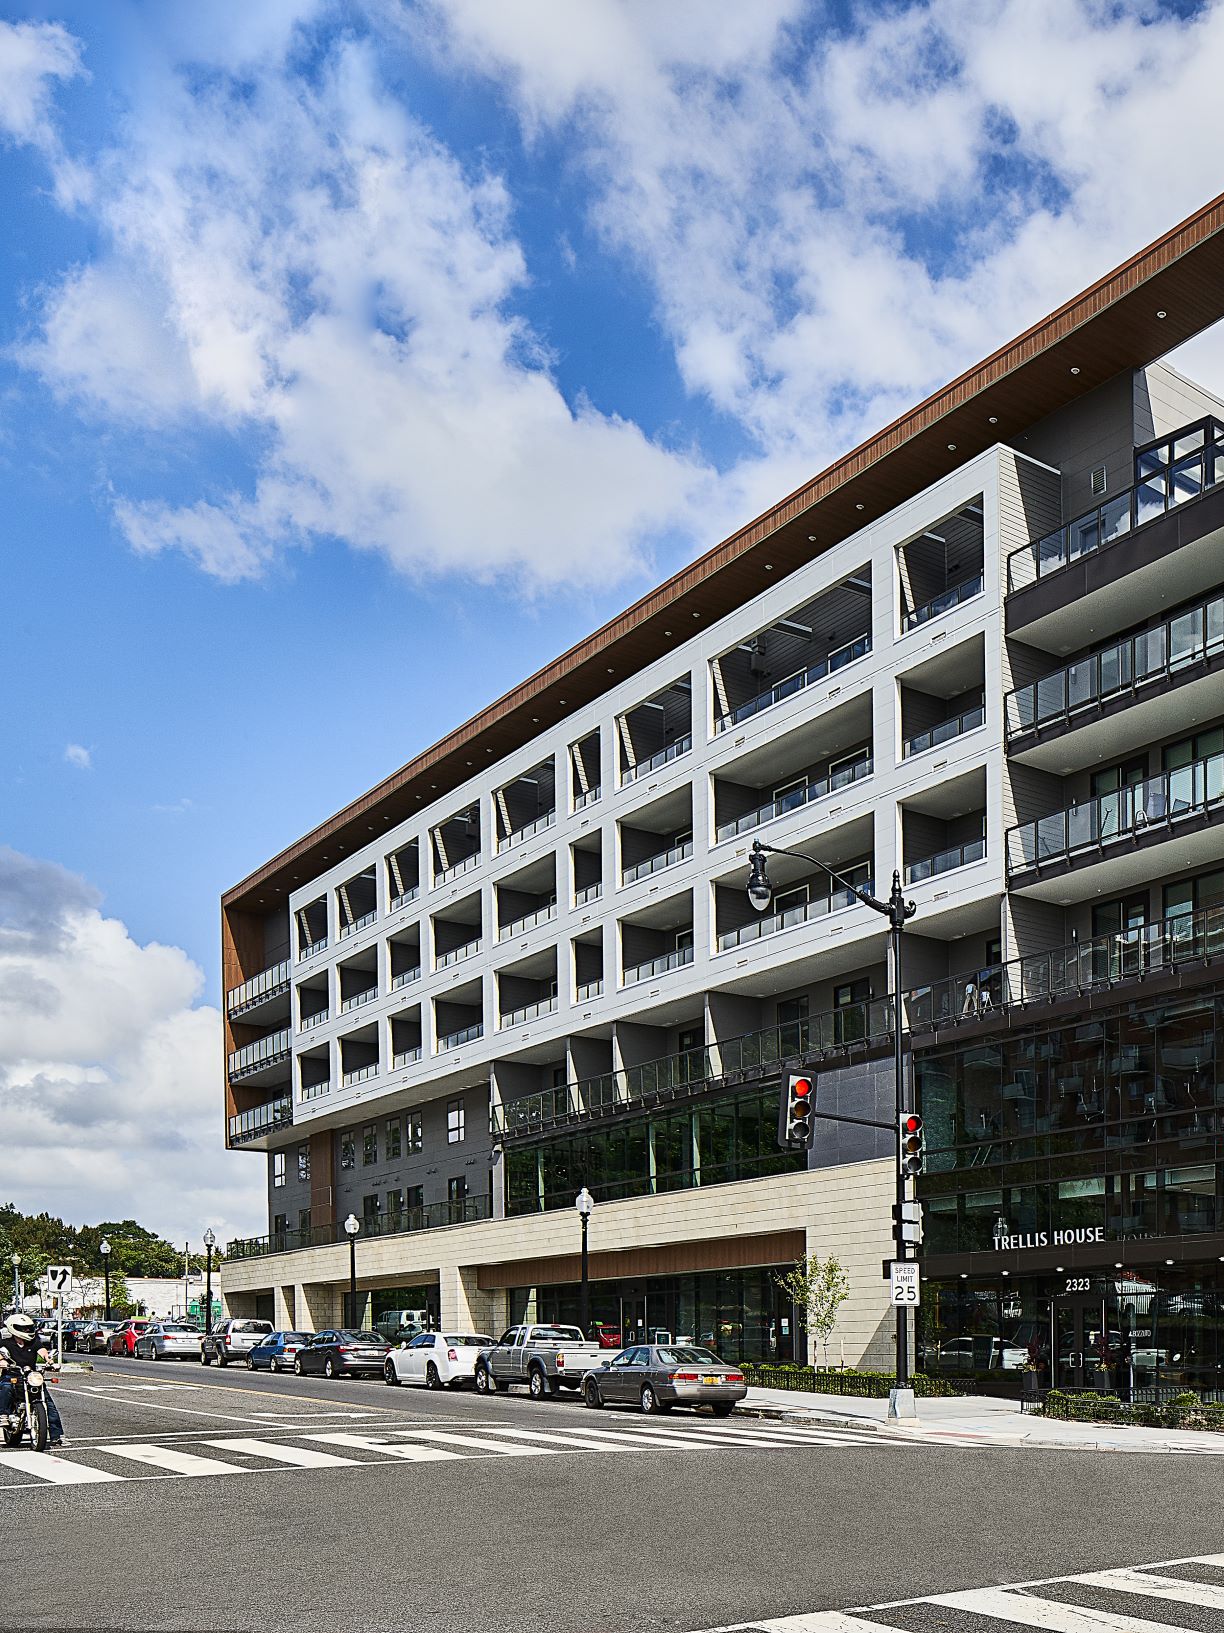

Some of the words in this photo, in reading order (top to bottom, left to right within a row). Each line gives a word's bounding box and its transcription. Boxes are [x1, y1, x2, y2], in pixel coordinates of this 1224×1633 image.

[993, 1231, 1048, 1251] TRELLIS
[1053, 1226, 1105, 1245] HOUSE
[894, 1267, 916, 1275] SPEED
[896, 1275, 914, 1283] LIMIT
[1065, 1278, 1090, 1292] 2323
[894, 1285, 917, 1301] 25
